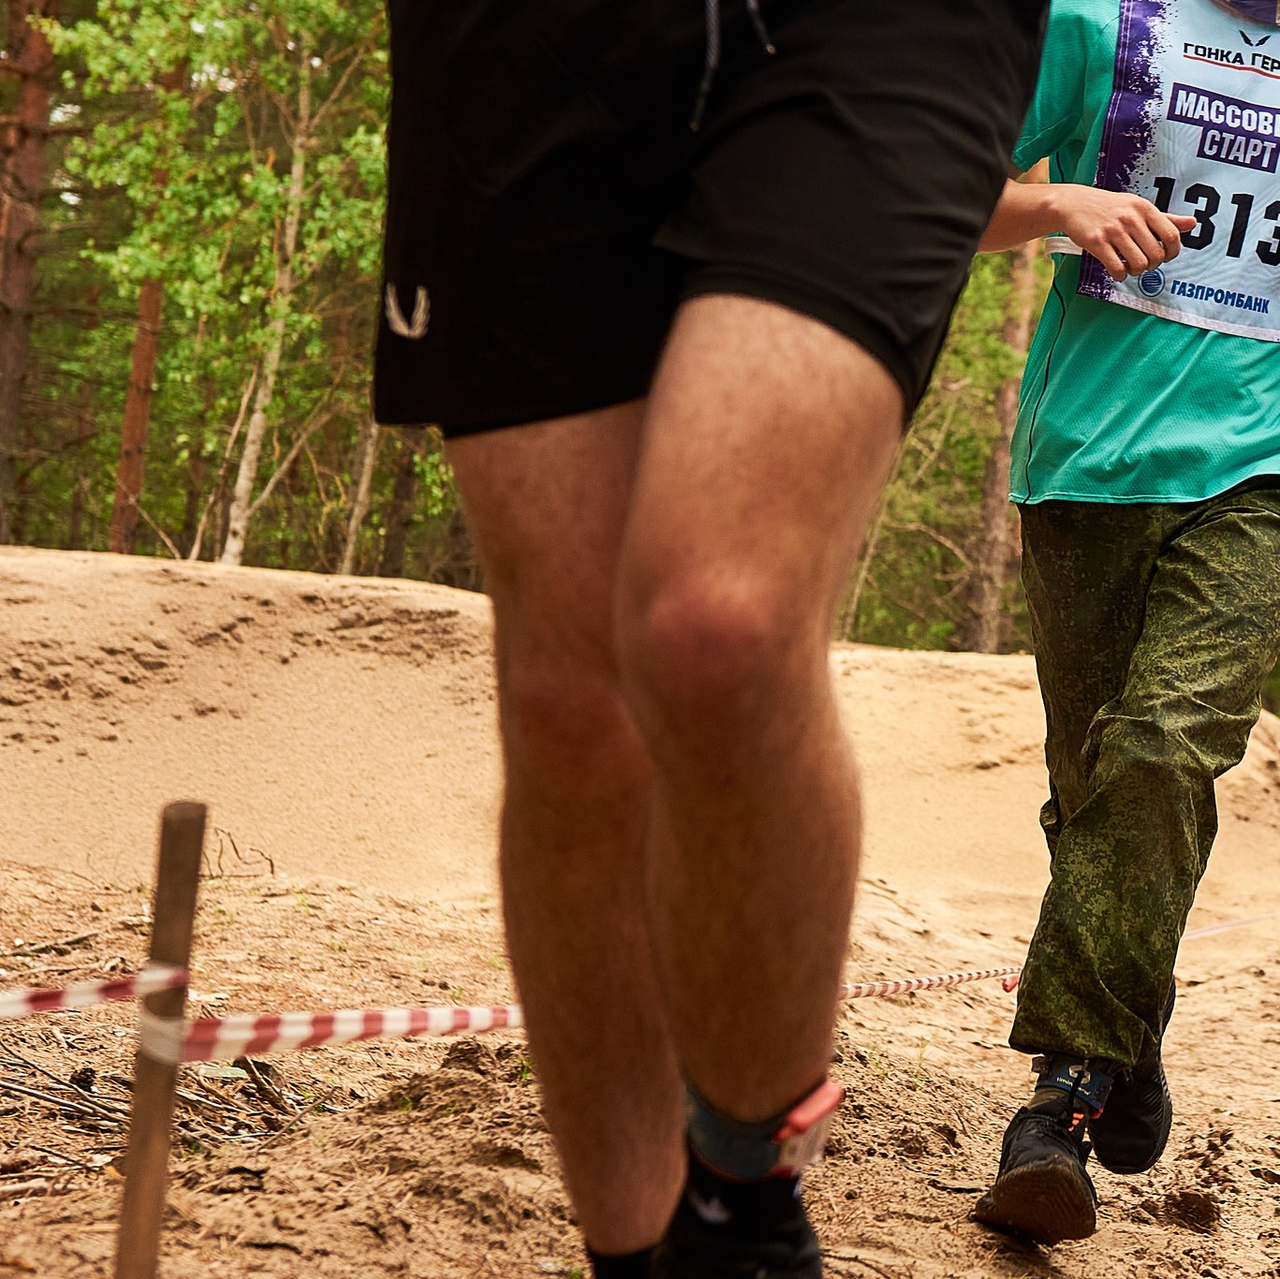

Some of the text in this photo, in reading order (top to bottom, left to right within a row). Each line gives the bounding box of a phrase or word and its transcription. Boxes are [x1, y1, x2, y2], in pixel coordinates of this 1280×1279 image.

[1183, 42, 1245, 65] ГОНКА
[1203, 129, 1277, 168] СТАРТ
[1170, 279, 1271, 314] ГАЗПРОМБАНК
